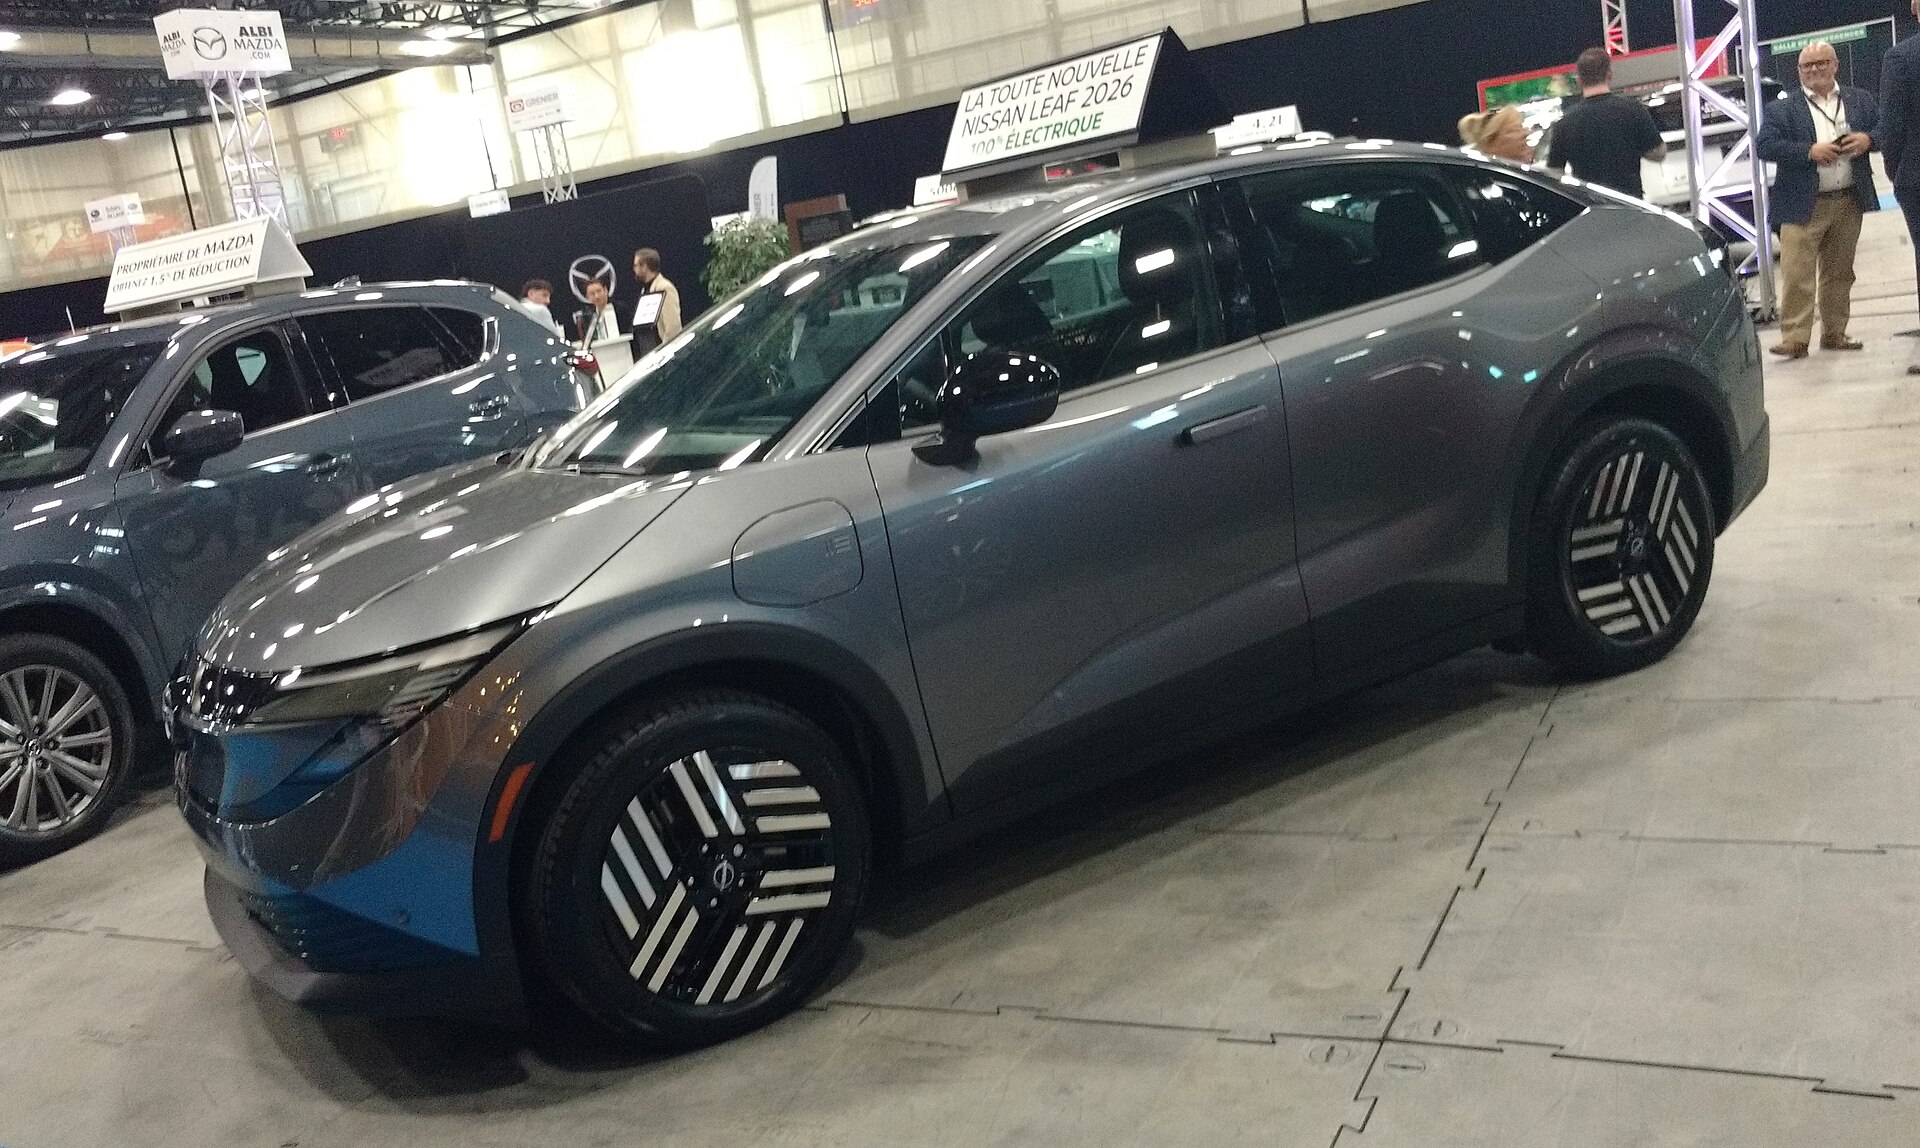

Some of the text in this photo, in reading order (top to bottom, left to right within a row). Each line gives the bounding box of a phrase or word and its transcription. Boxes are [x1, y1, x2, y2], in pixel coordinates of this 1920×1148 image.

[163, 30, 181, 43] ALBI
[233, 38, 283, 50] MAZDA
[239, 26, 274, 37] ALBI
[161, 38, 187, 52] MAZDA
[250, 51, 271, 60] .COM
[964, 44, 1149, 113] LA TOUTE NOUVELLE
[962, 74, 1135, 138] NISSAN LEAF 2026
[1005, 111, 1105, 151] ÉLECTRIQUE
[116, 233, 255, 276] PROPRIÉTAIRE DE MAZDA
[112, 277, 149, 293] OBTENEZ
[172, 269, 186, 282] DE
[188, 254, 252, 278] RÉDUCTION
